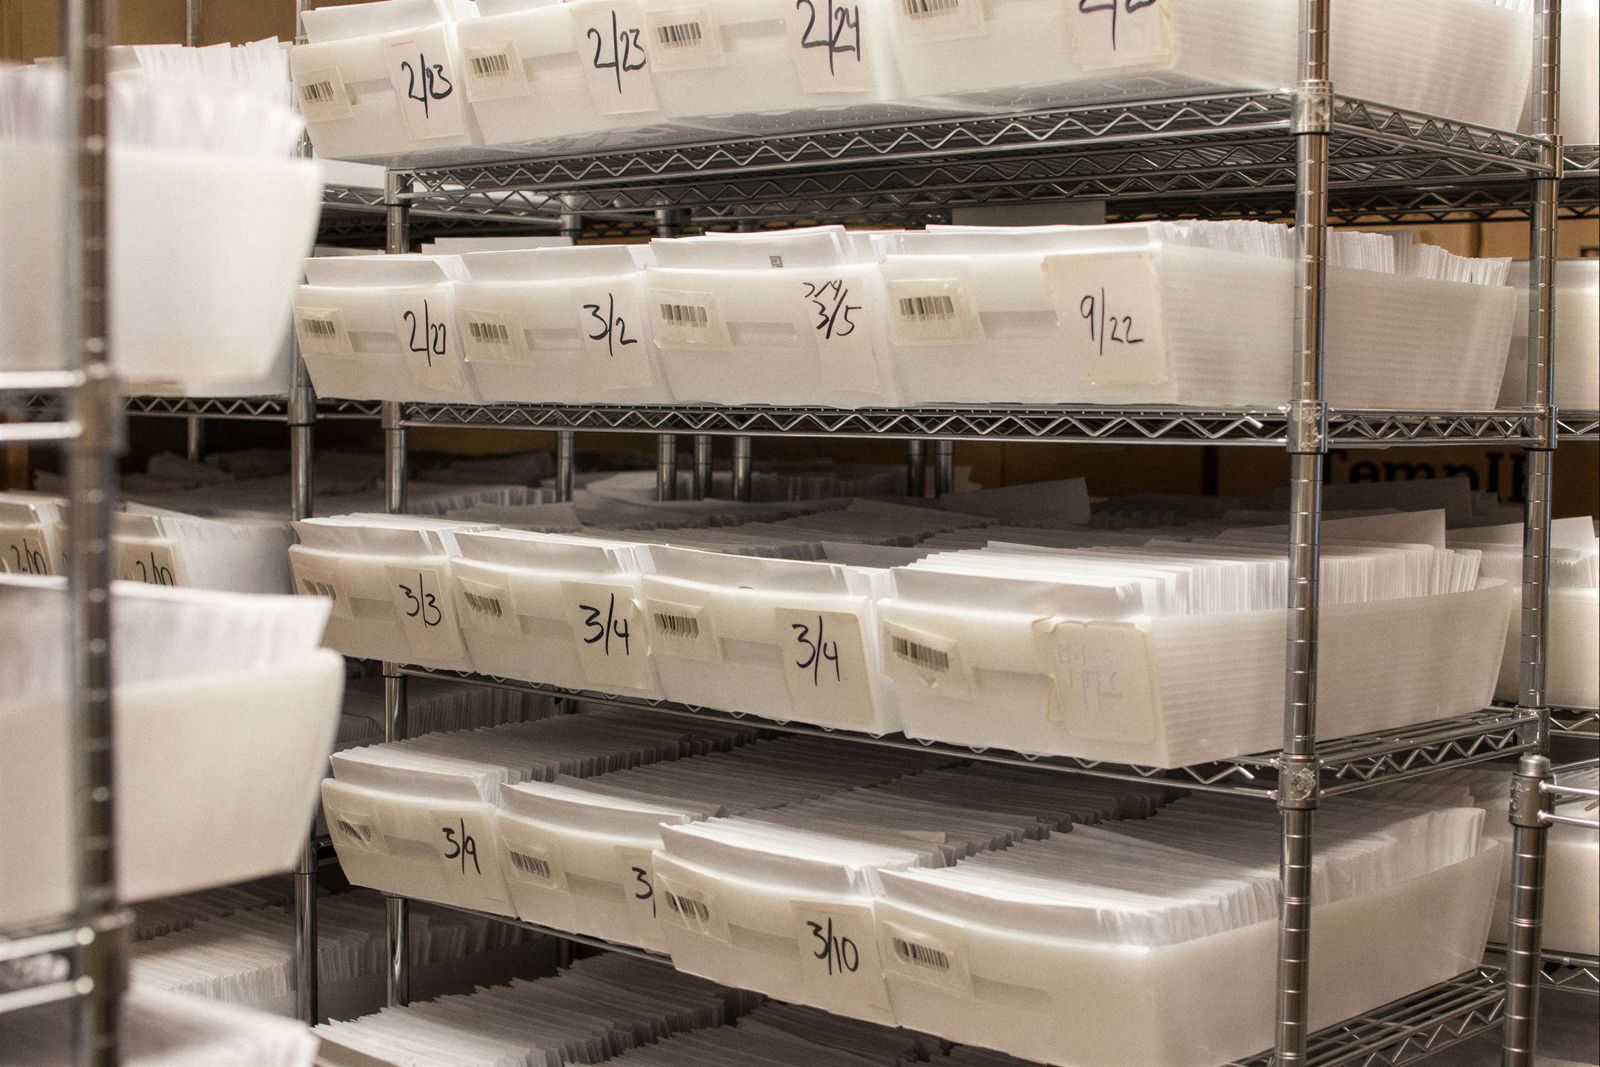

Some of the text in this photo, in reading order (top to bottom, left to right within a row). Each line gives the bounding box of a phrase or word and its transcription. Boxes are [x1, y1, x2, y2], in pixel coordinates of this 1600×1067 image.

[587, 10, 646, 94] 2/23
[796, 0, 861, 77] 2/24
[401, 52, 453, 119] 2/23
[583, 293, 637, 357] 3/2
[812, 288, 862, 339] 3/5
[1080, 287, 1144, 356] 9/22
[399, 573, 442, 628] 3/3
[579, 592, 629, 655] 3/4
[792, 615, 841, 686] 3/4
[442, 817, 481, 875] 3/9
[807, 917, 859, 976] 3/10
